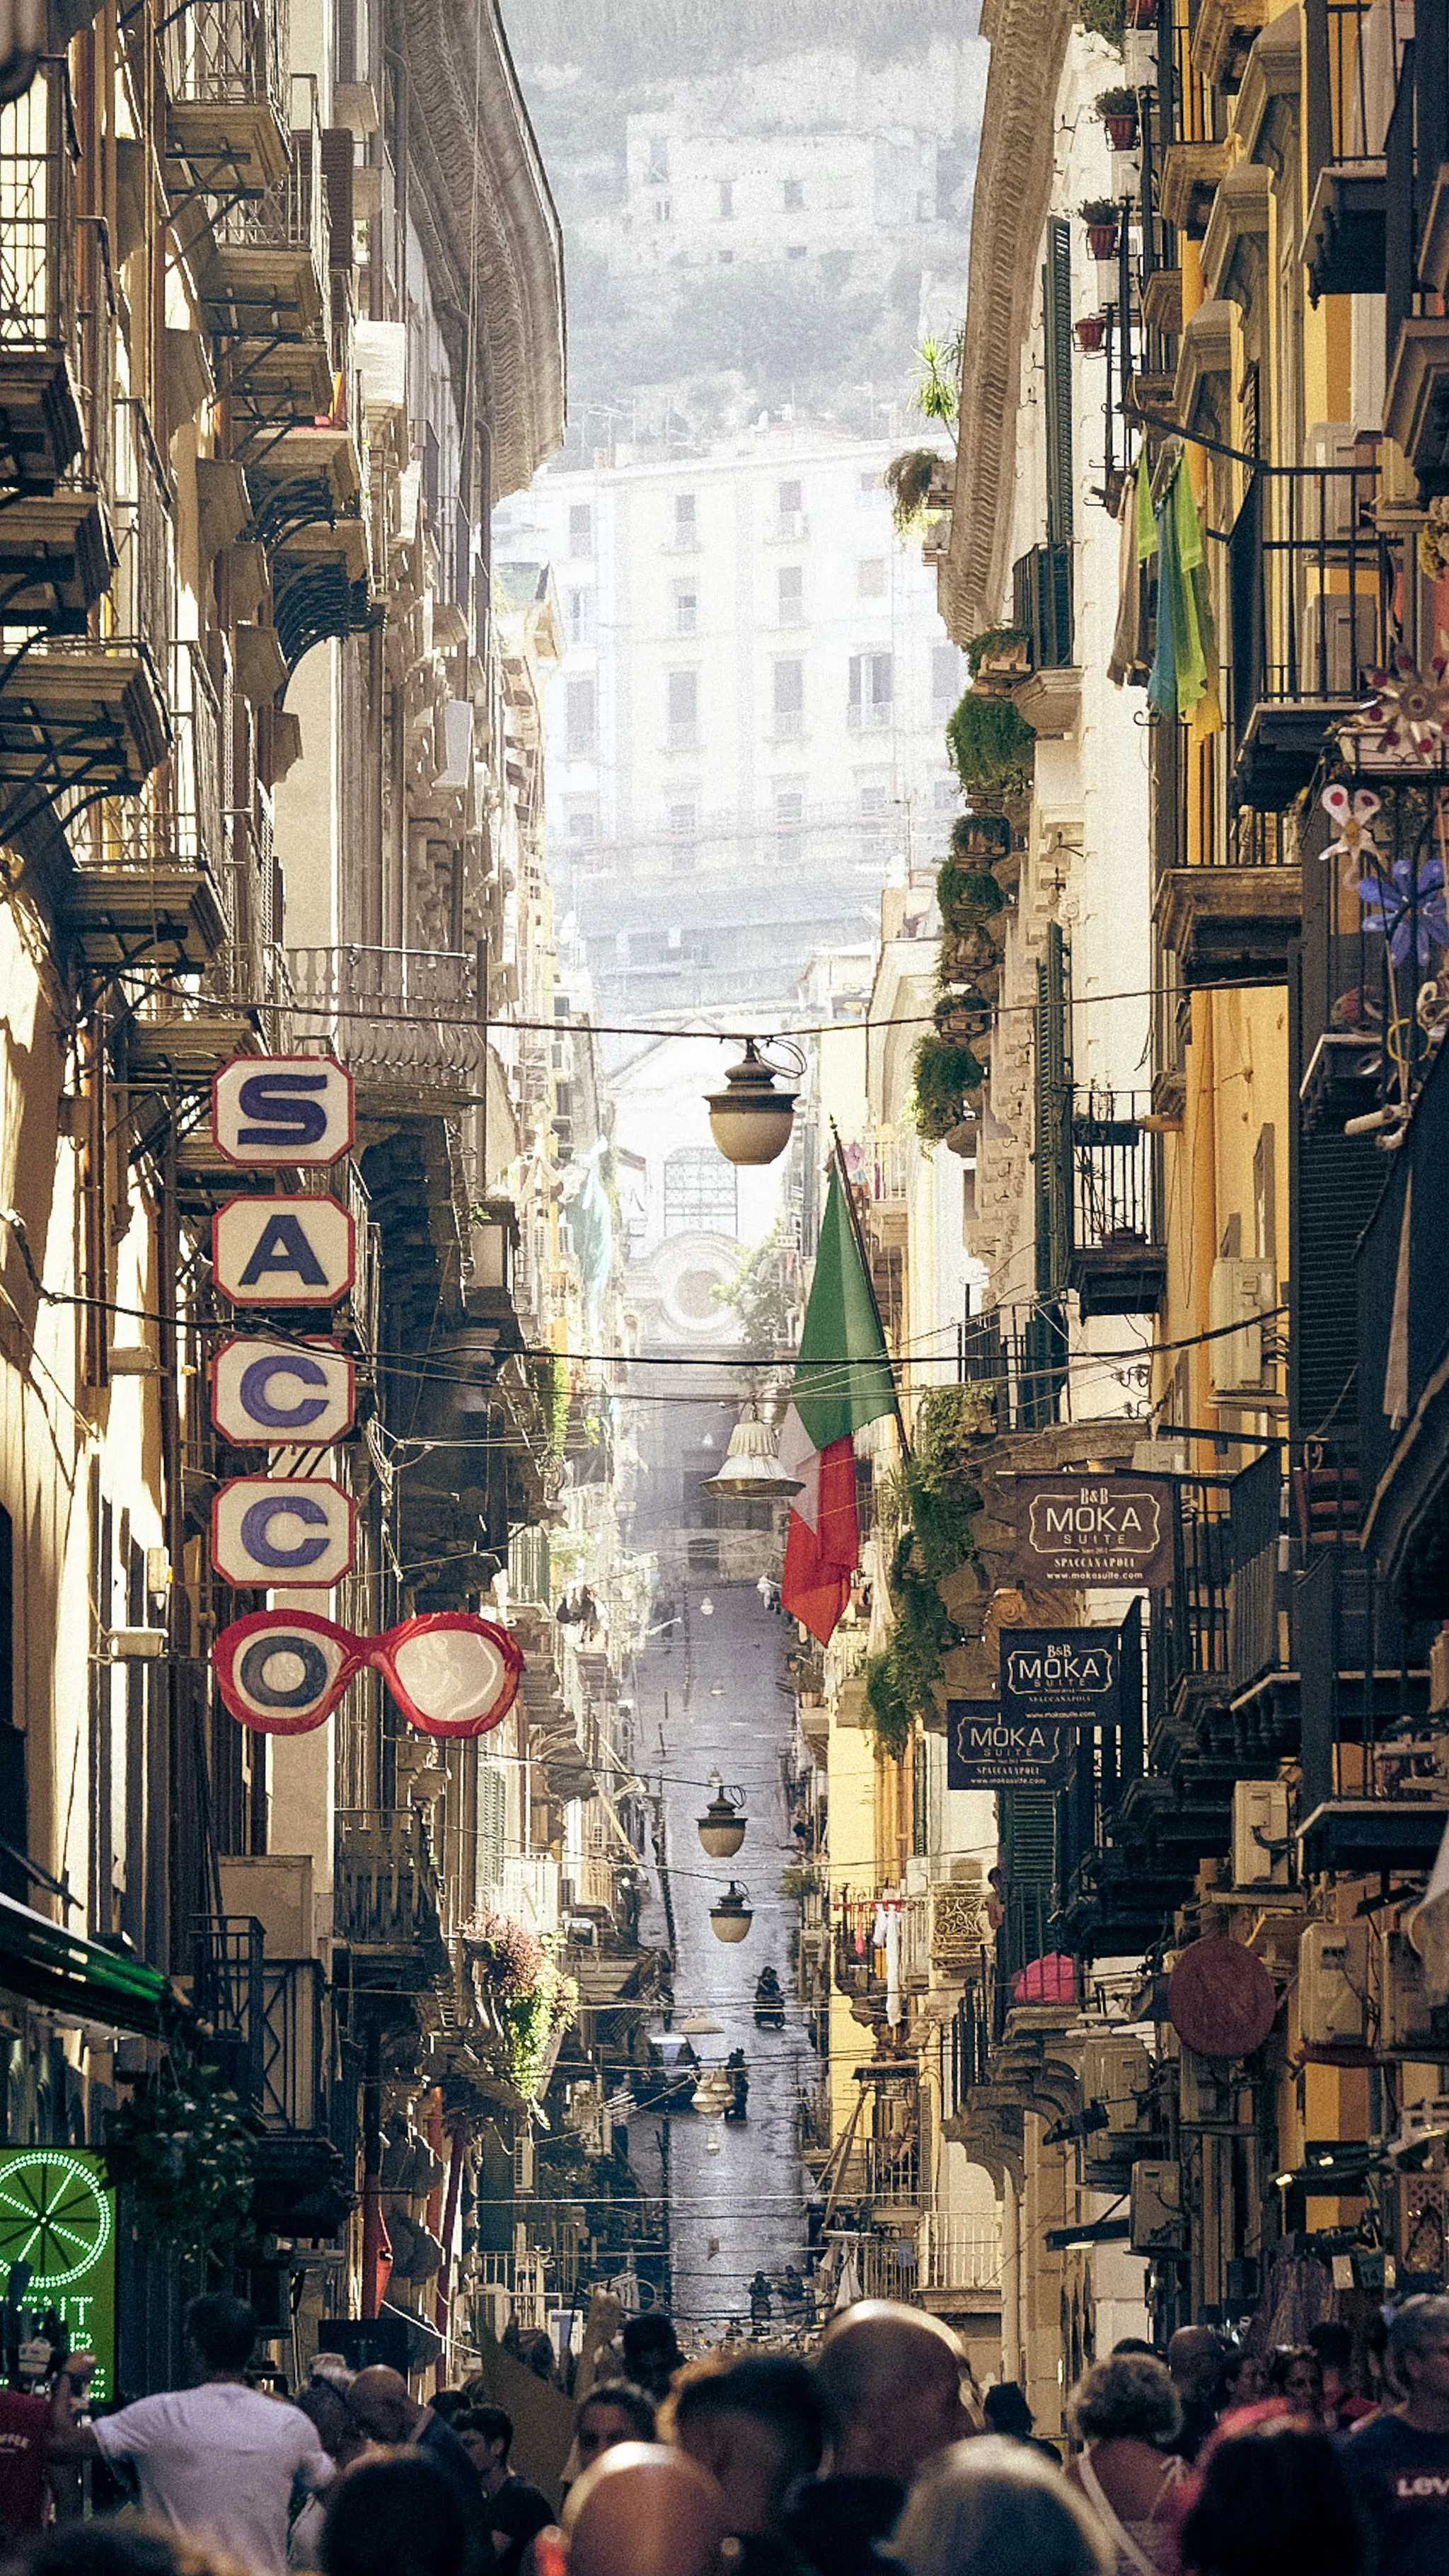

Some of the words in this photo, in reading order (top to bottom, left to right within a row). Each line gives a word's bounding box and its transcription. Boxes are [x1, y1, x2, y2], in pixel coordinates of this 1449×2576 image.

[238, 1074, 330, 1708] SACCO
[1080, 1488, 1109, 1505] B&B
[1046, 1507, 1142, 1532] MOKA
[1063, 1534, 1126, 1545] SUITE
[1046, 1571, 1144, 1580] www.mokasuite.com
[1047, 1644, 1072, 1658] B&B
[1019, 1657, 1100, 1679] MOKA
[1034, 1679, 1086, 1688] SUITE
[971, 1727, 1045, 1747] MOKA
[983, 1747, 1034, 1757] SUITE
